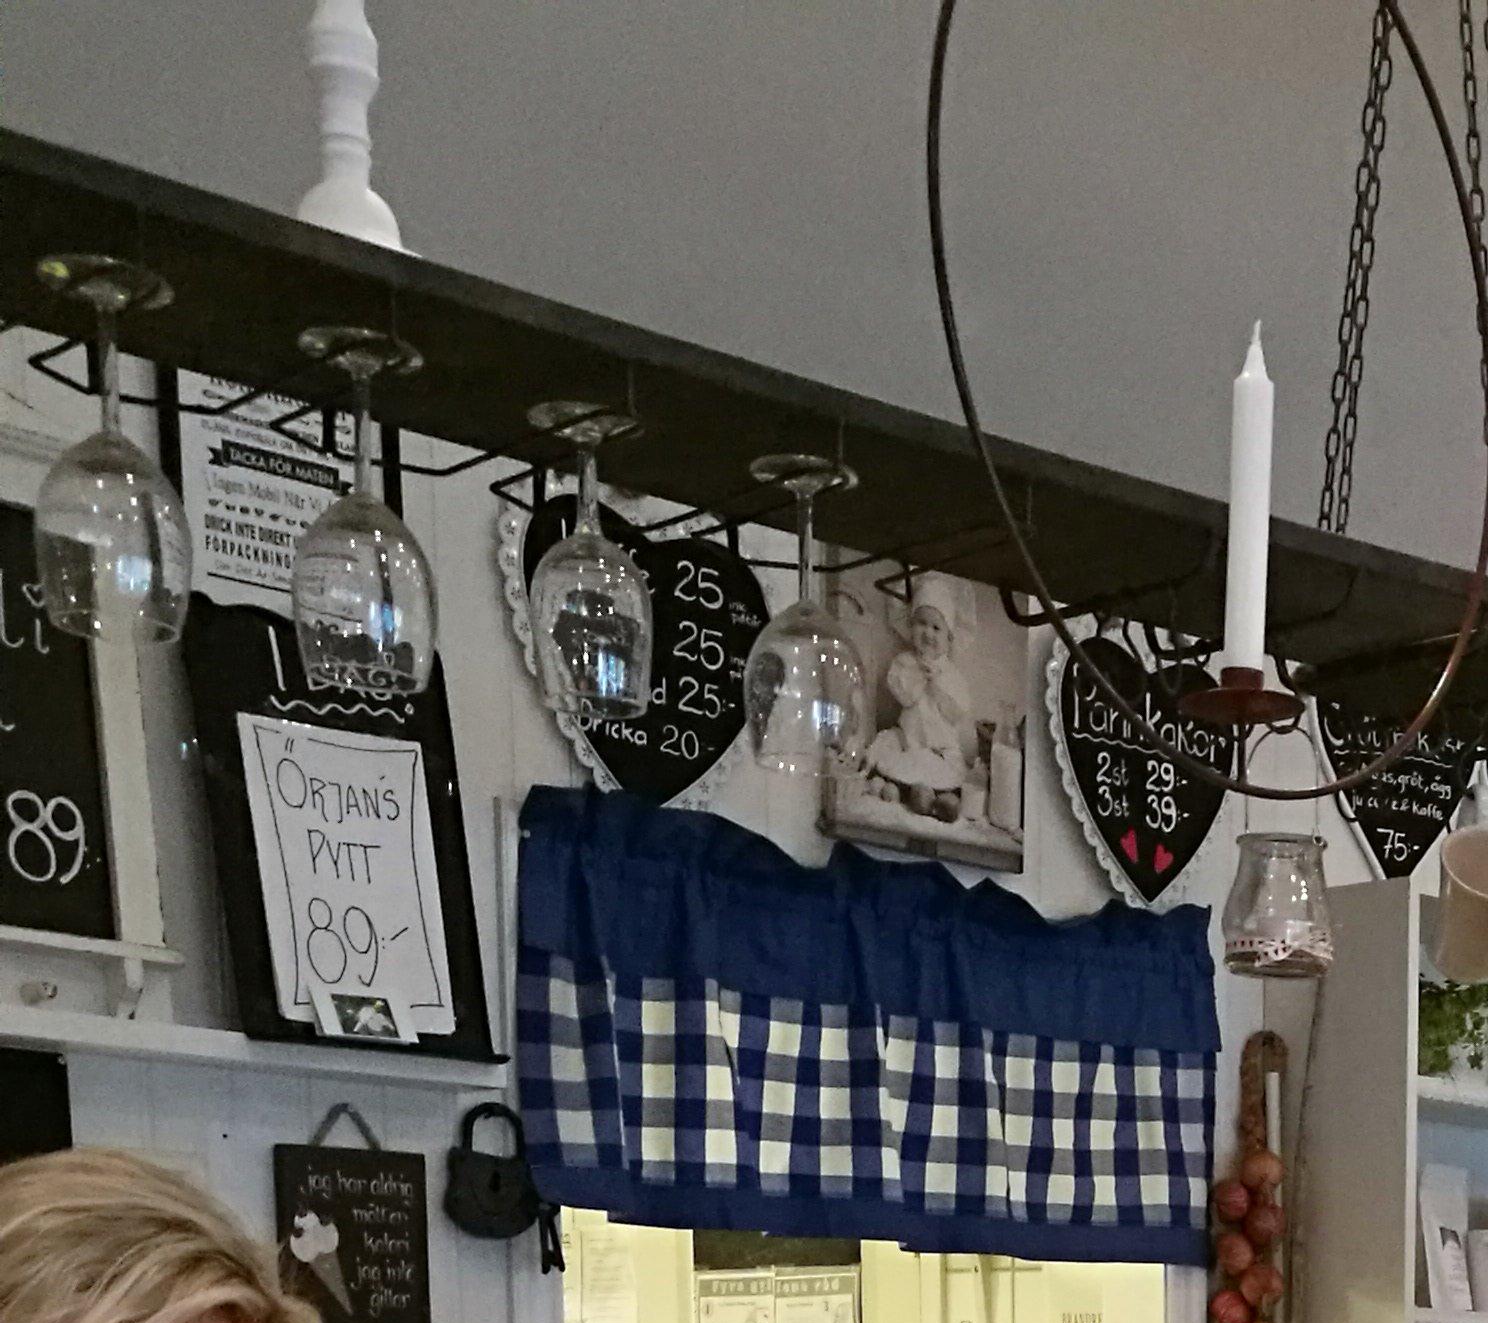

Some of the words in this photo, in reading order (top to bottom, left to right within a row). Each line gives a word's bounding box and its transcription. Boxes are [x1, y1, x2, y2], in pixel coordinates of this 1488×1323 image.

[674, 560, 724, 610] 25
[673, 620, 724, 671] 25
[576, 711, 649, 747] Dricka
[306, 829, 382, 885] PYTT
[1376, 827, 1420, 862] 75:-
[306, 898, 410, 988] 89:-
